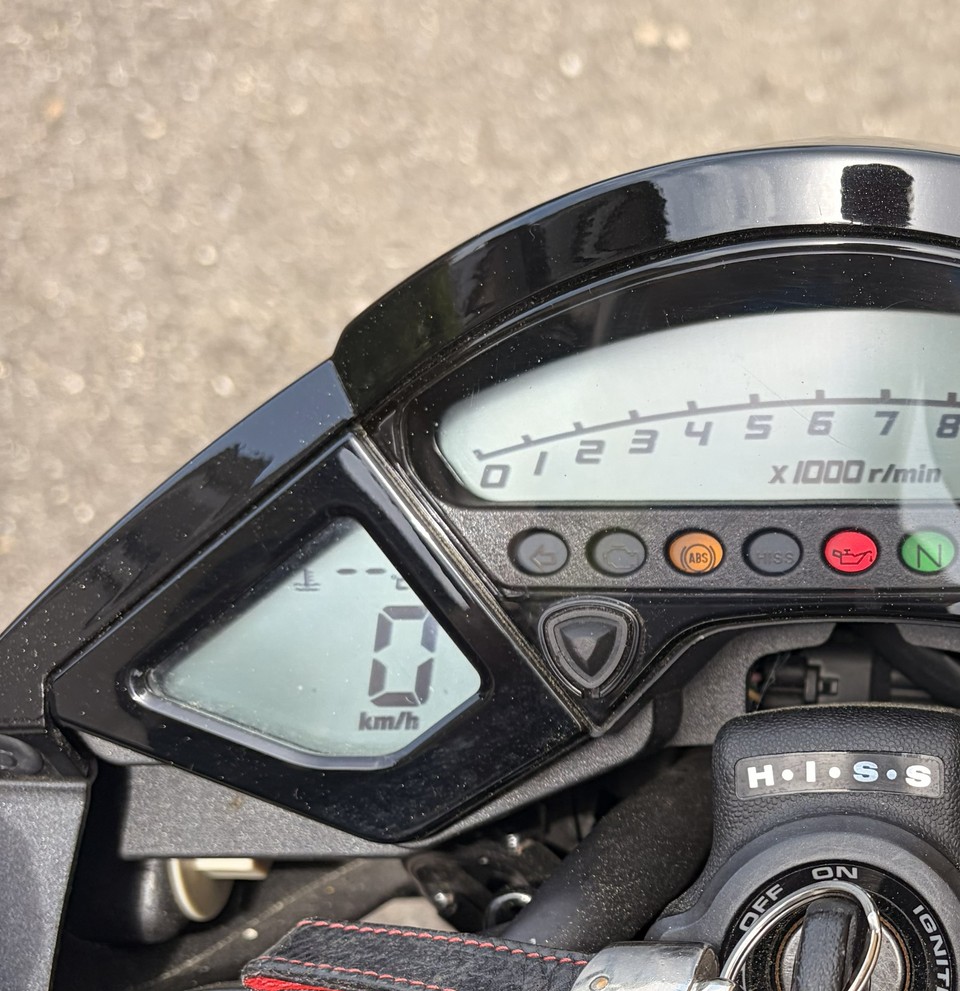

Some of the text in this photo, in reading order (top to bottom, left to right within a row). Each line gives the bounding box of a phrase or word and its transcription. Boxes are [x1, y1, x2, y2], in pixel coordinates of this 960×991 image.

[480, 464, 509, 488] 0
[533, 450, 548, 476] 1
[575, 440, 605, 464] 2
[629, 429, 659, 454] 3
[685, 420, 713, 446] 4
[744, 414, 774, 440] 5
[807, 411, 835, 436] 6
[874, 411, 900, 436] 7
[688, 552, 709, 564] ABS
[756, 551, 794, 565] HISS
[917, 544, 943, 569] N
[368, 605, 438, 707] 0
[359, 712, 420, 731] km/h
[812, 865, 858, 880] ON
[739, 883, 783, 932] OFF
